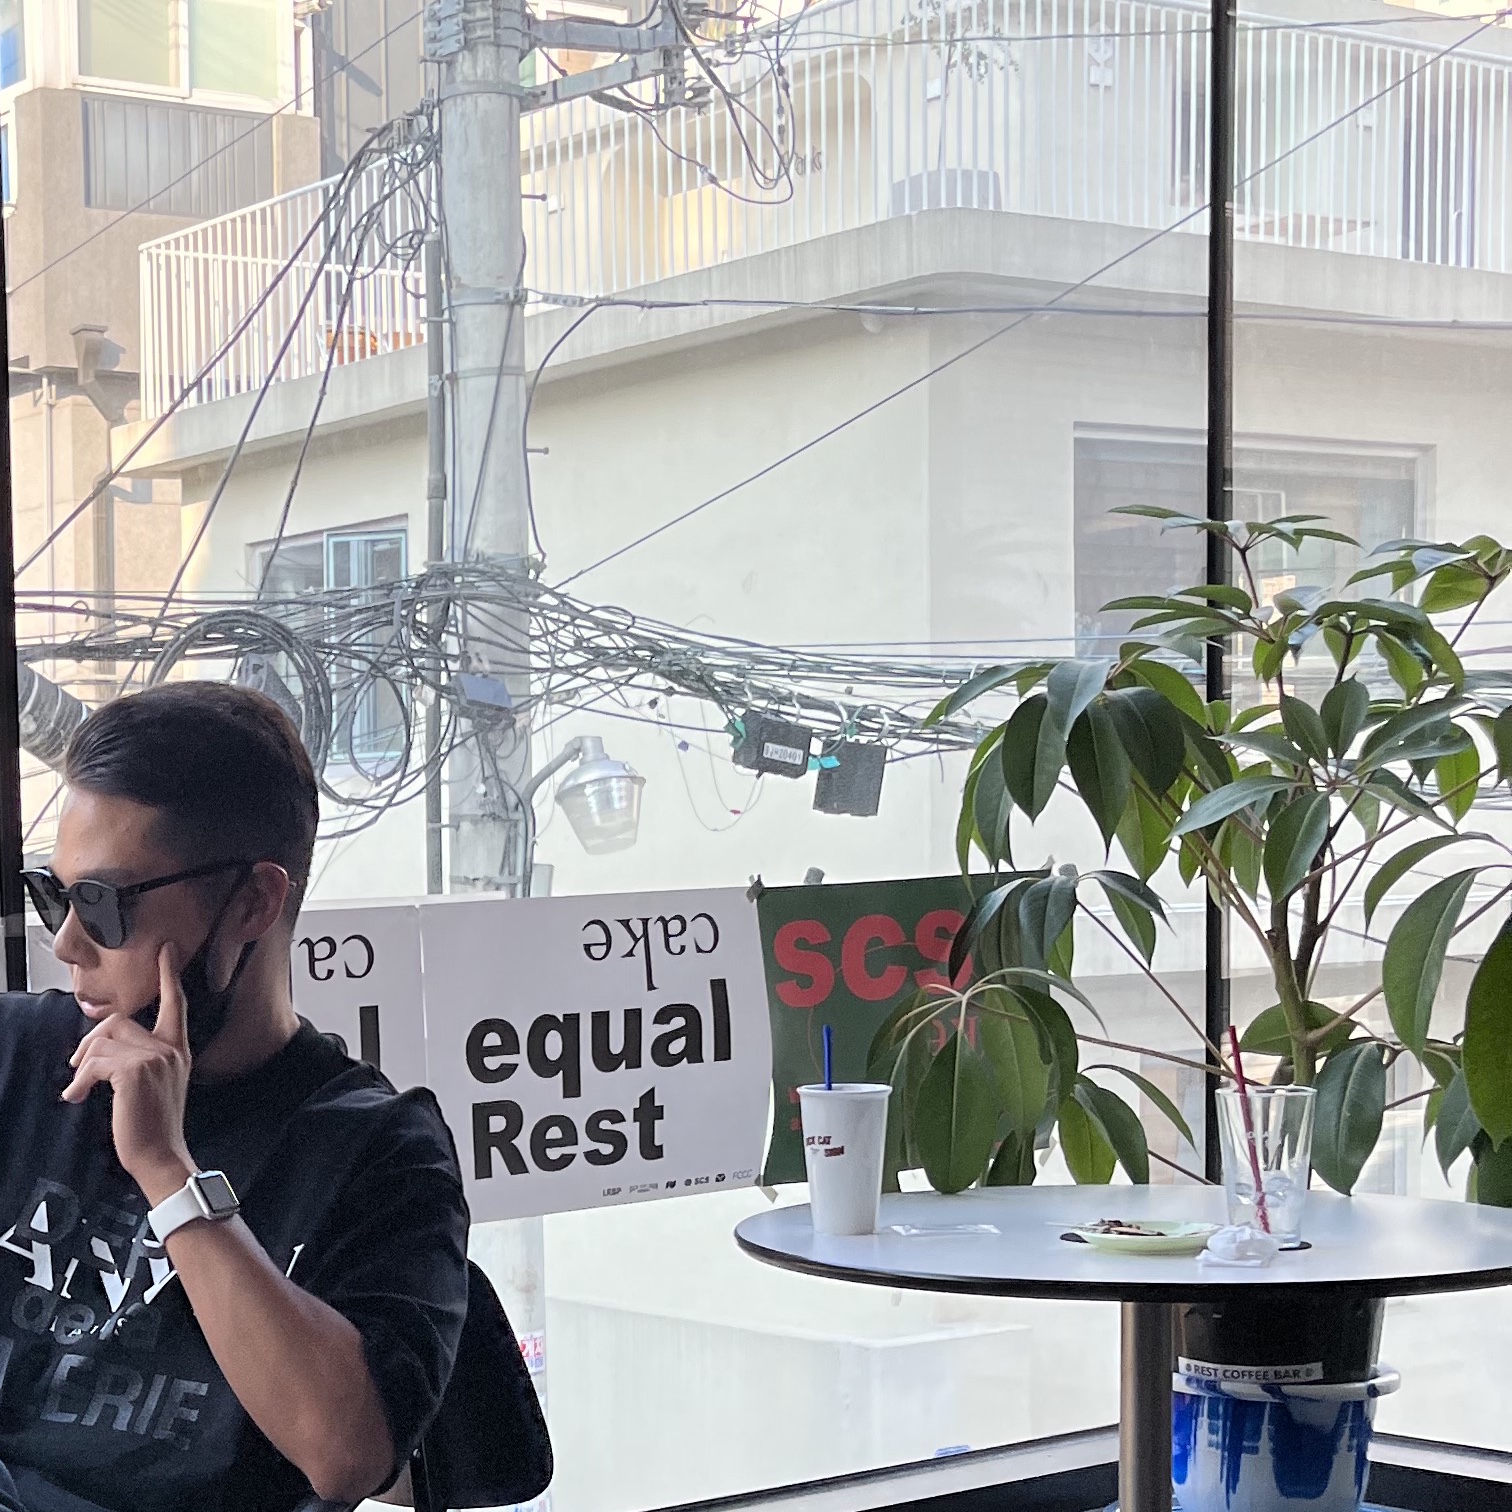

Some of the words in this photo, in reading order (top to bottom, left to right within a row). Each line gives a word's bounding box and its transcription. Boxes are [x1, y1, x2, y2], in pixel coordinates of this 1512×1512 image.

[582, 912, 720, 992] cake
[774, 910, 972, 1007] SCS
[465, 978, 732, 1098] equal
[472, 1086, 665, 1180] Rest
[1194, 1365, 1219, 1377] REST
[1222, 1369, 1270, 1380] COFFEE
